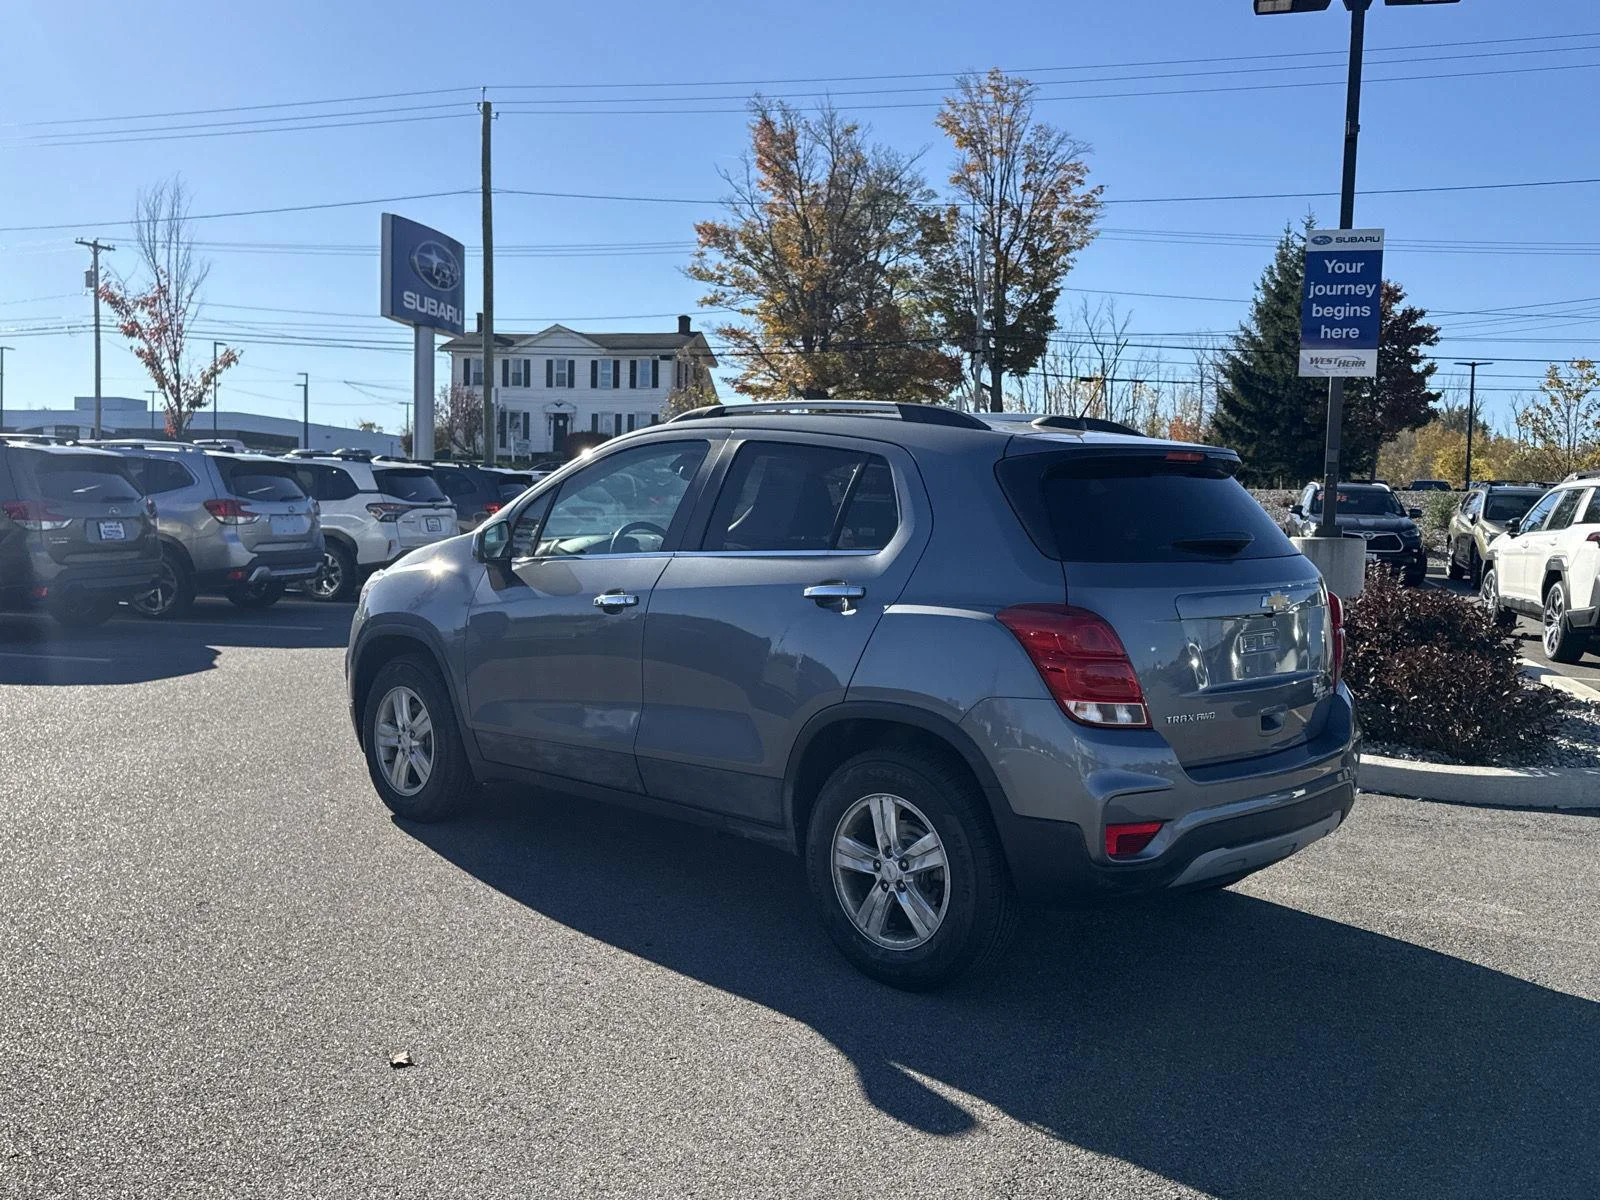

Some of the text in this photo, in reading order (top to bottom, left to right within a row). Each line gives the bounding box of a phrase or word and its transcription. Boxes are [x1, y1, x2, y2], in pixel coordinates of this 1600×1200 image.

[1336, 236, 1380, 244] SUBARU
[1324, 259, 1364, 273] Your
[1308, 282, 1376, 298] journey
[403, 291, 462, 324] SUBARU
[1312, 303, 1371, 320] begins
[1320, 325, 1359, 339] here
[1166, 711, 1215, 724] TRAX AWD
